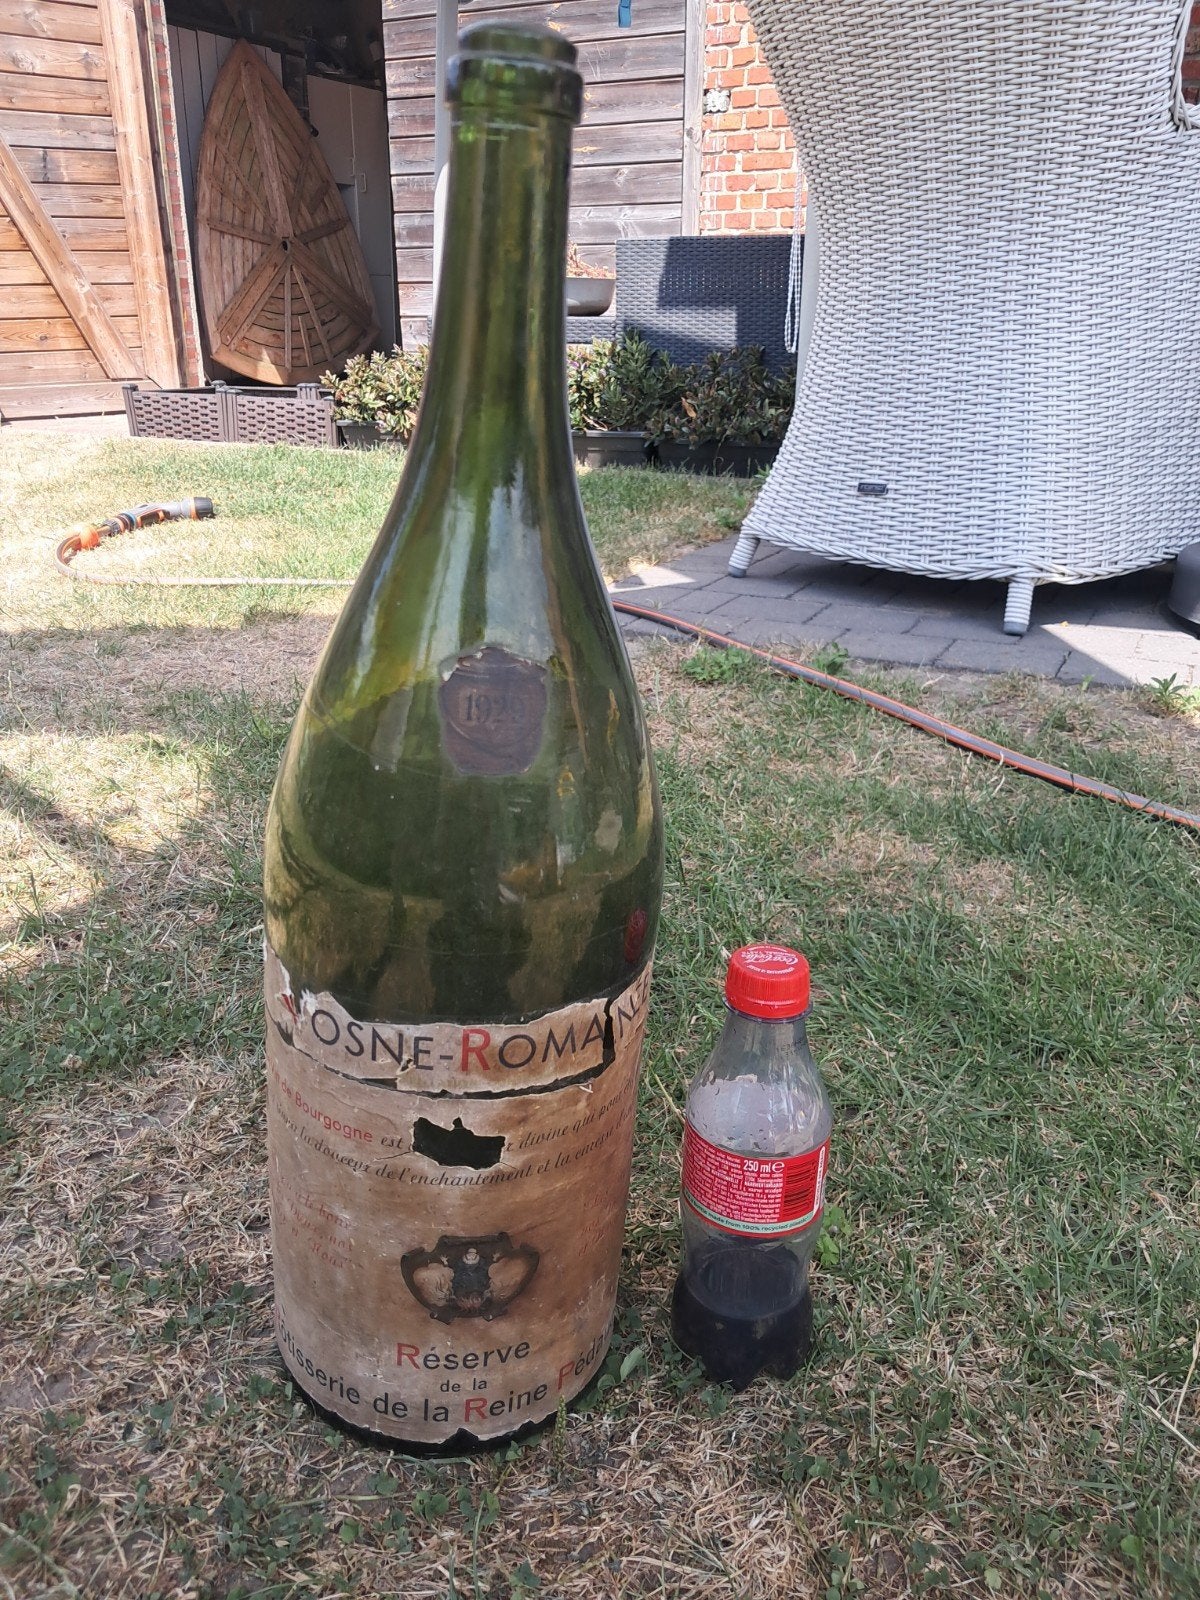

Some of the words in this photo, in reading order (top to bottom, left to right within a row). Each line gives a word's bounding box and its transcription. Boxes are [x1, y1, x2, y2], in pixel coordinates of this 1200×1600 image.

[295, 1091, 373, 1142] Bourgogne
[381, 1136, 403, 1150] est
[315, 1139, 372, 1172] douceur
[376, 1163, 394, 1179] de
[537, 1159, 551, 1175] et
[554, 1151, 571, 1169] la
[743, 1159, 759, 1172] 250
[760, 1162, 771, 1173] ml
[707, 1211, 725, 1224] made
[725, 1218, 741, 1230] from
[742, 1223, 760, 1232] 100%
[761, 1223, 788, 1232] recycled
[396, 1341, 530, 1371] Réserve
[440, 1379, 461, 1393] de
[472, 1377, 487, 1391] la
[373, 1392, 408, 1419] de
[423, 1398, 449, 1423] la
[464, 1383, 548, 1423] Reine
